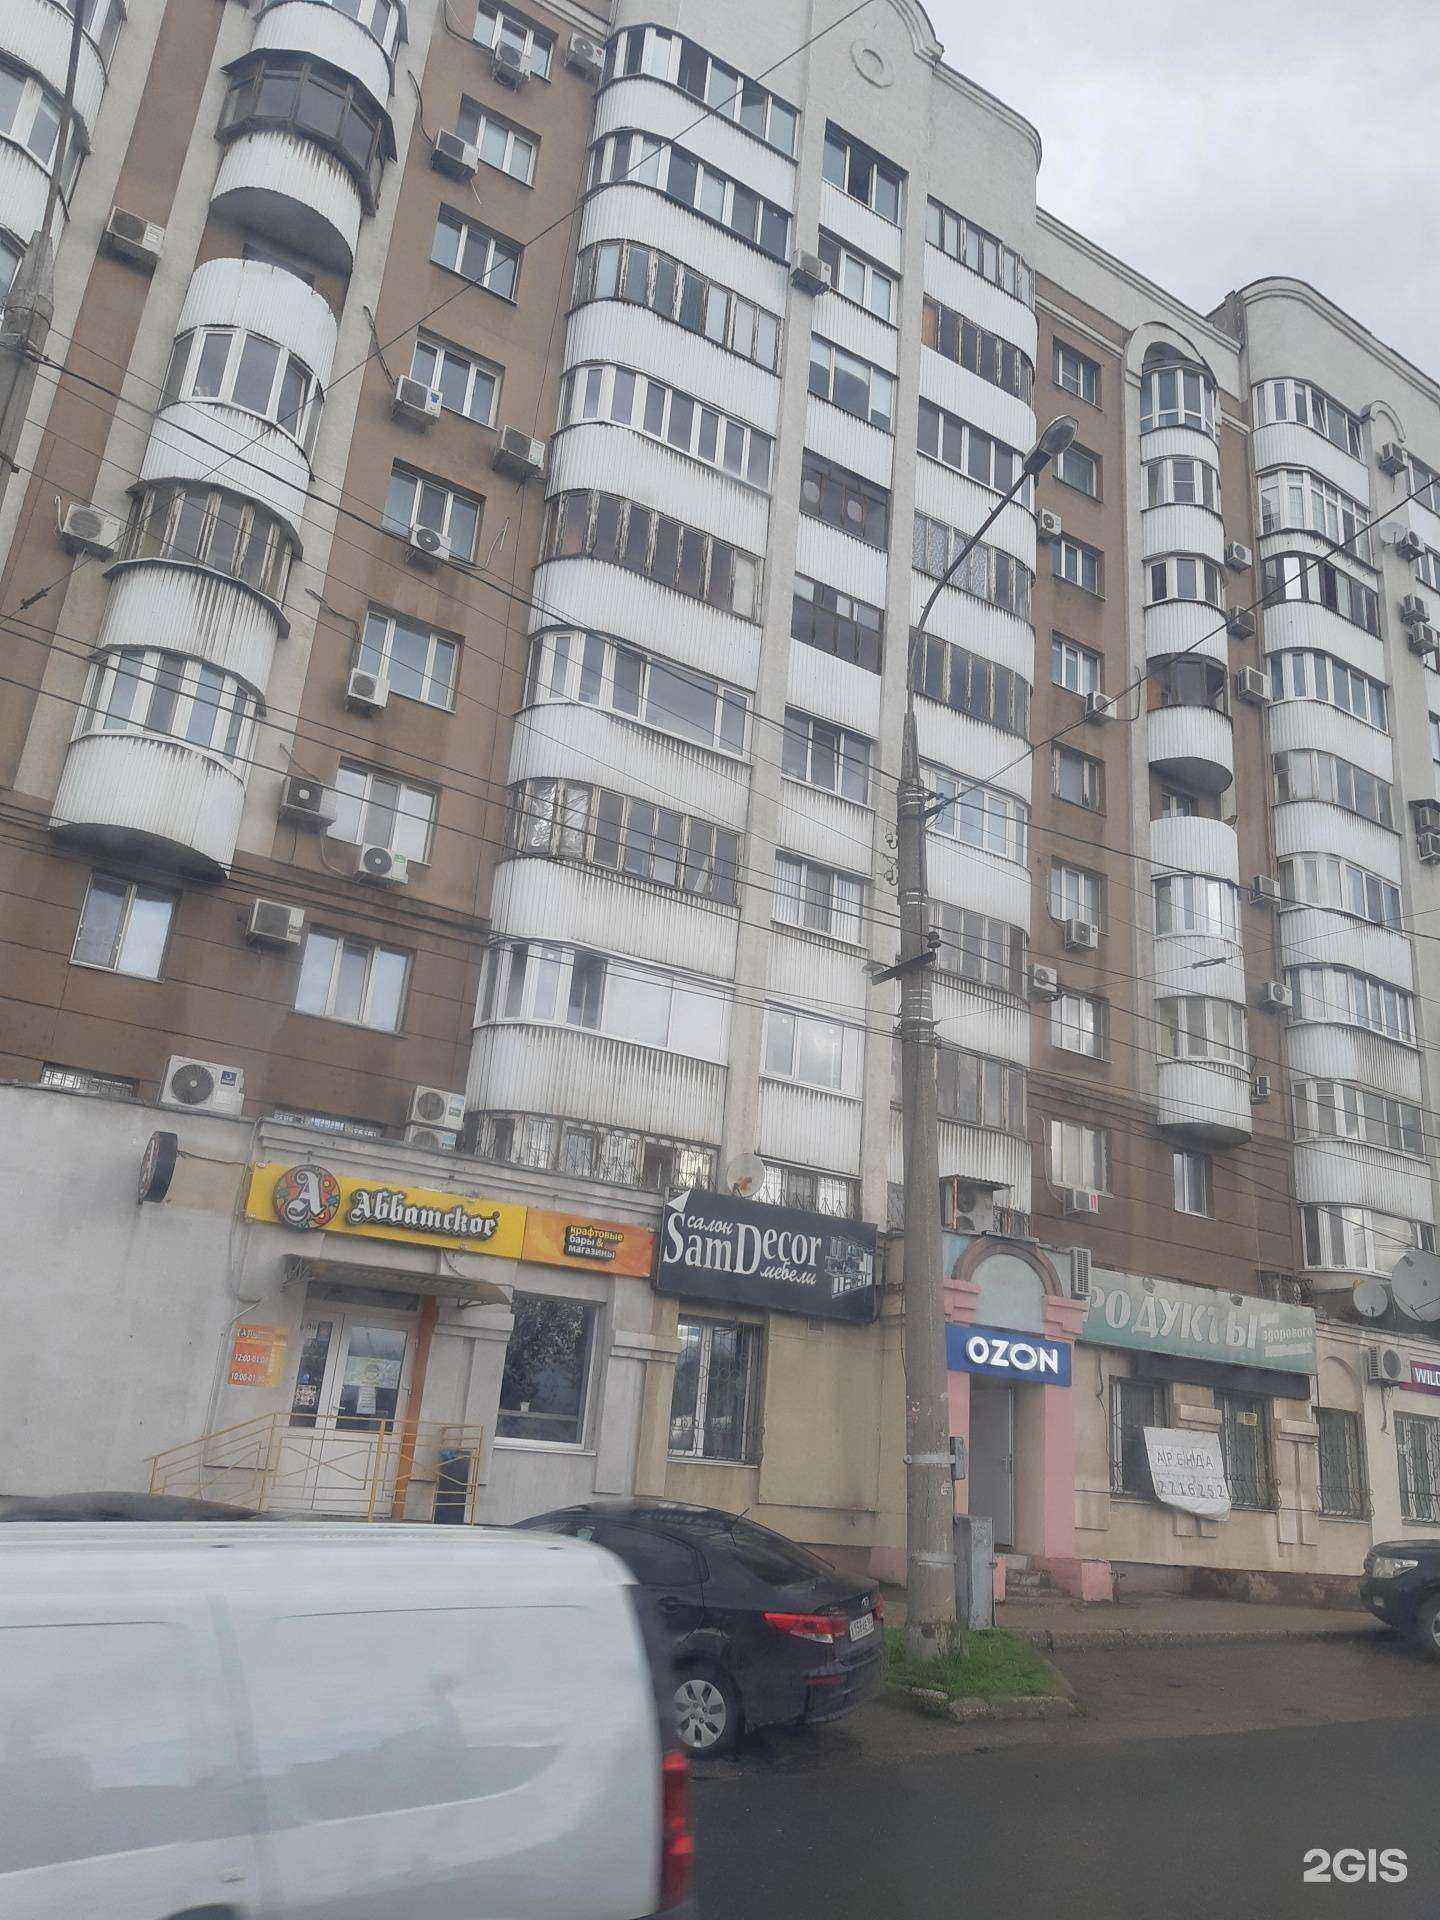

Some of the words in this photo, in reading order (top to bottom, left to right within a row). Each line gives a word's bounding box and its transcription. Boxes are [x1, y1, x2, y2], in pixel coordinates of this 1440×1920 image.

[570, 1226, 624, 1241] крафтовые
[687, 1215, 733, 1235] салон
[569, 1234, 595, 1247] бары
[596, 1237, 604, 1248] &
[663, 1212, 822, 1275] SamDecor
[568, 1244, 615, 1259] магазины
[760, 1261, 817, 1285] мебели
[1089, 1286, 1259, 1350] РОДУКТЫ
[966, 1336, 1058, 1375] OZON
[1157, 1450, 1214, 1469] АРЕНДА
